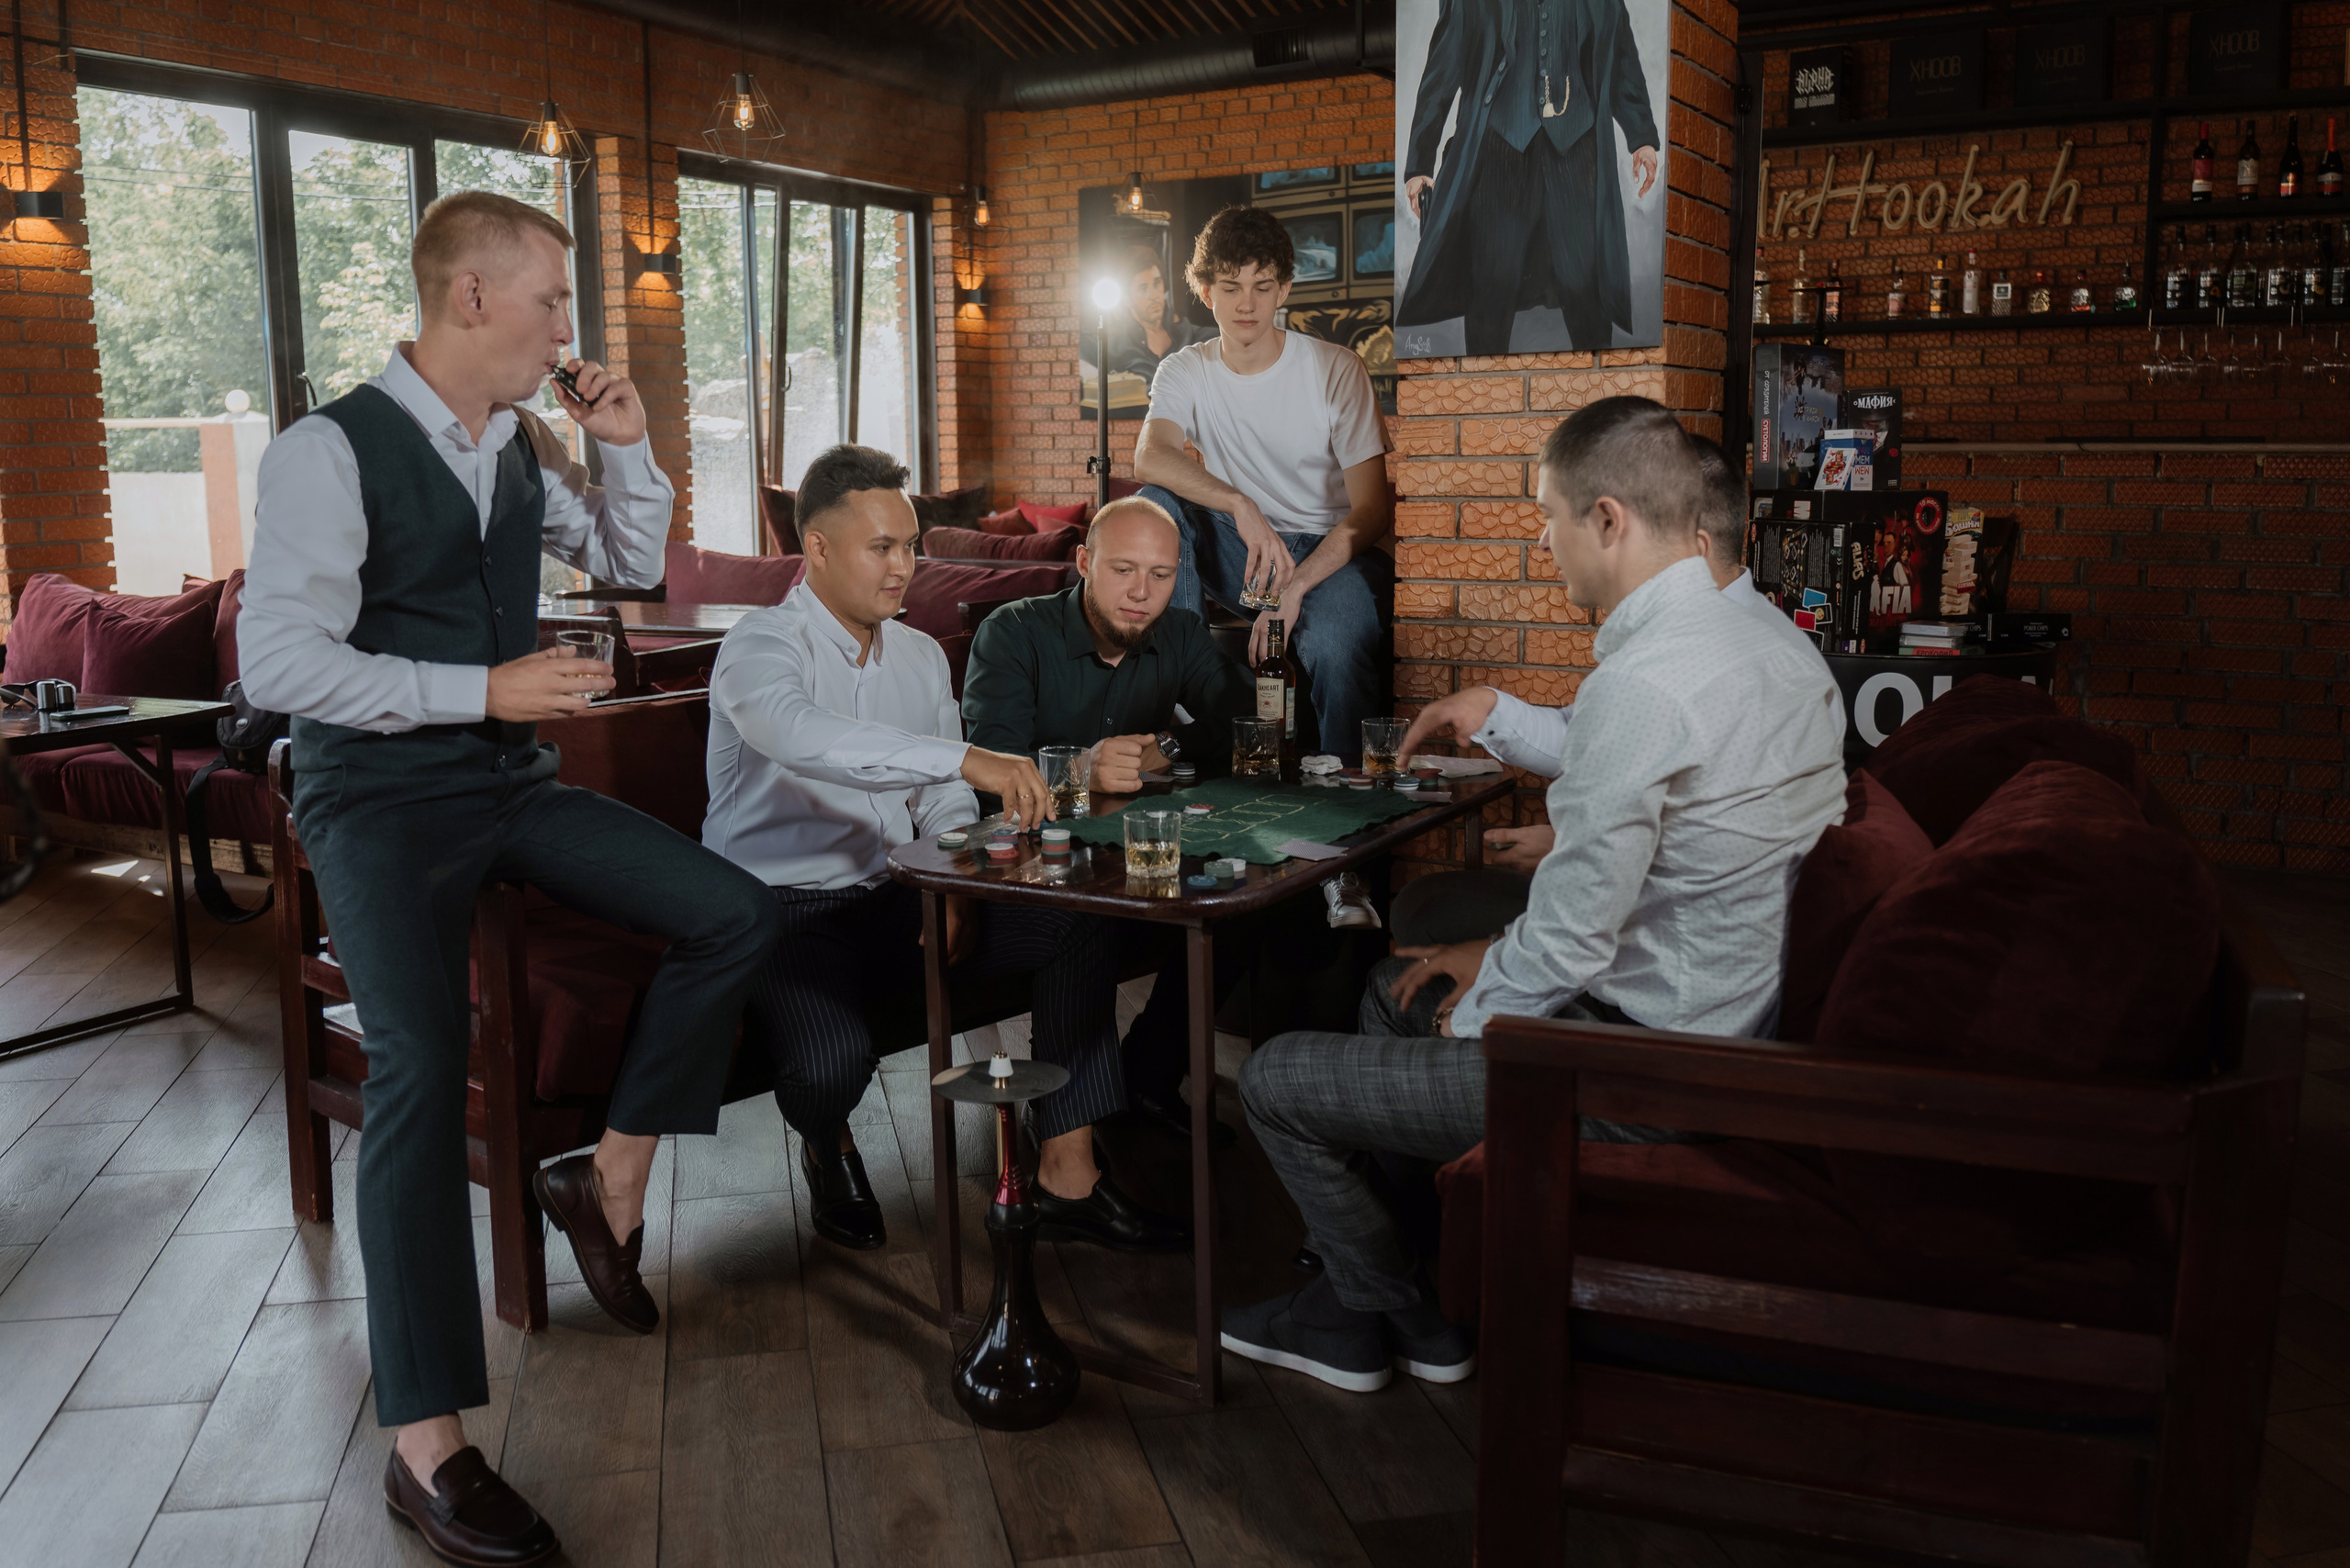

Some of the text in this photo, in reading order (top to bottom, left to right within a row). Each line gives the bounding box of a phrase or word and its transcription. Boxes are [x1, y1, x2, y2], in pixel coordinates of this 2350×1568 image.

[1909, 55, 1962, 82] XHOOB
[1857, 395, 1894, 409] МАФИЯ
[1851, 542, 1864, 580] ALIAS
